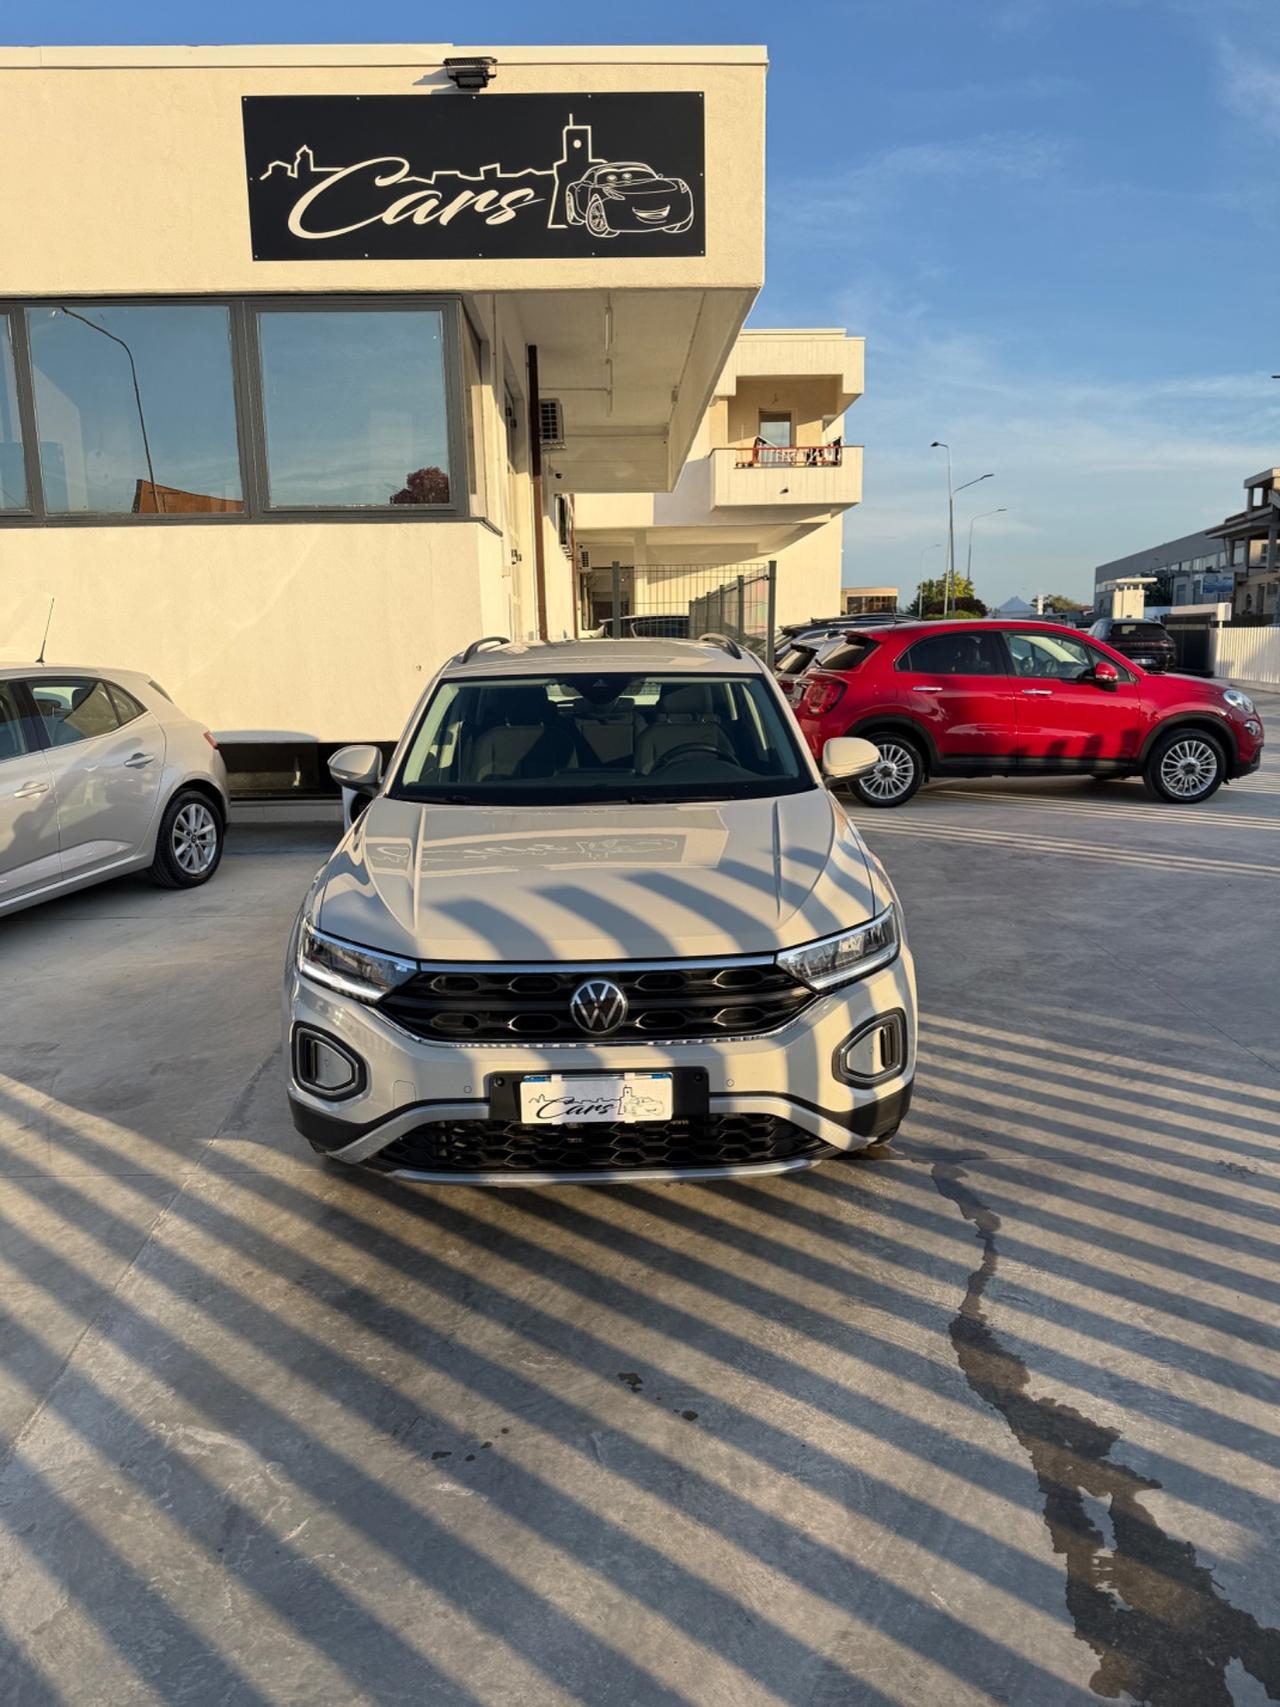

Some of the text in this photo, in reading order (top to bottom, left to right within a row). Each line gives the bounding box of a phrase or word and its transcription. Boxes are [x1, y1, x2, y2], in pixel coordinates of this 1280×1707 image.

[287, 156, 546, 239] Cars
[572, 981, 626, 1031] VW
[536, 1096, 615, 1119] Cars
